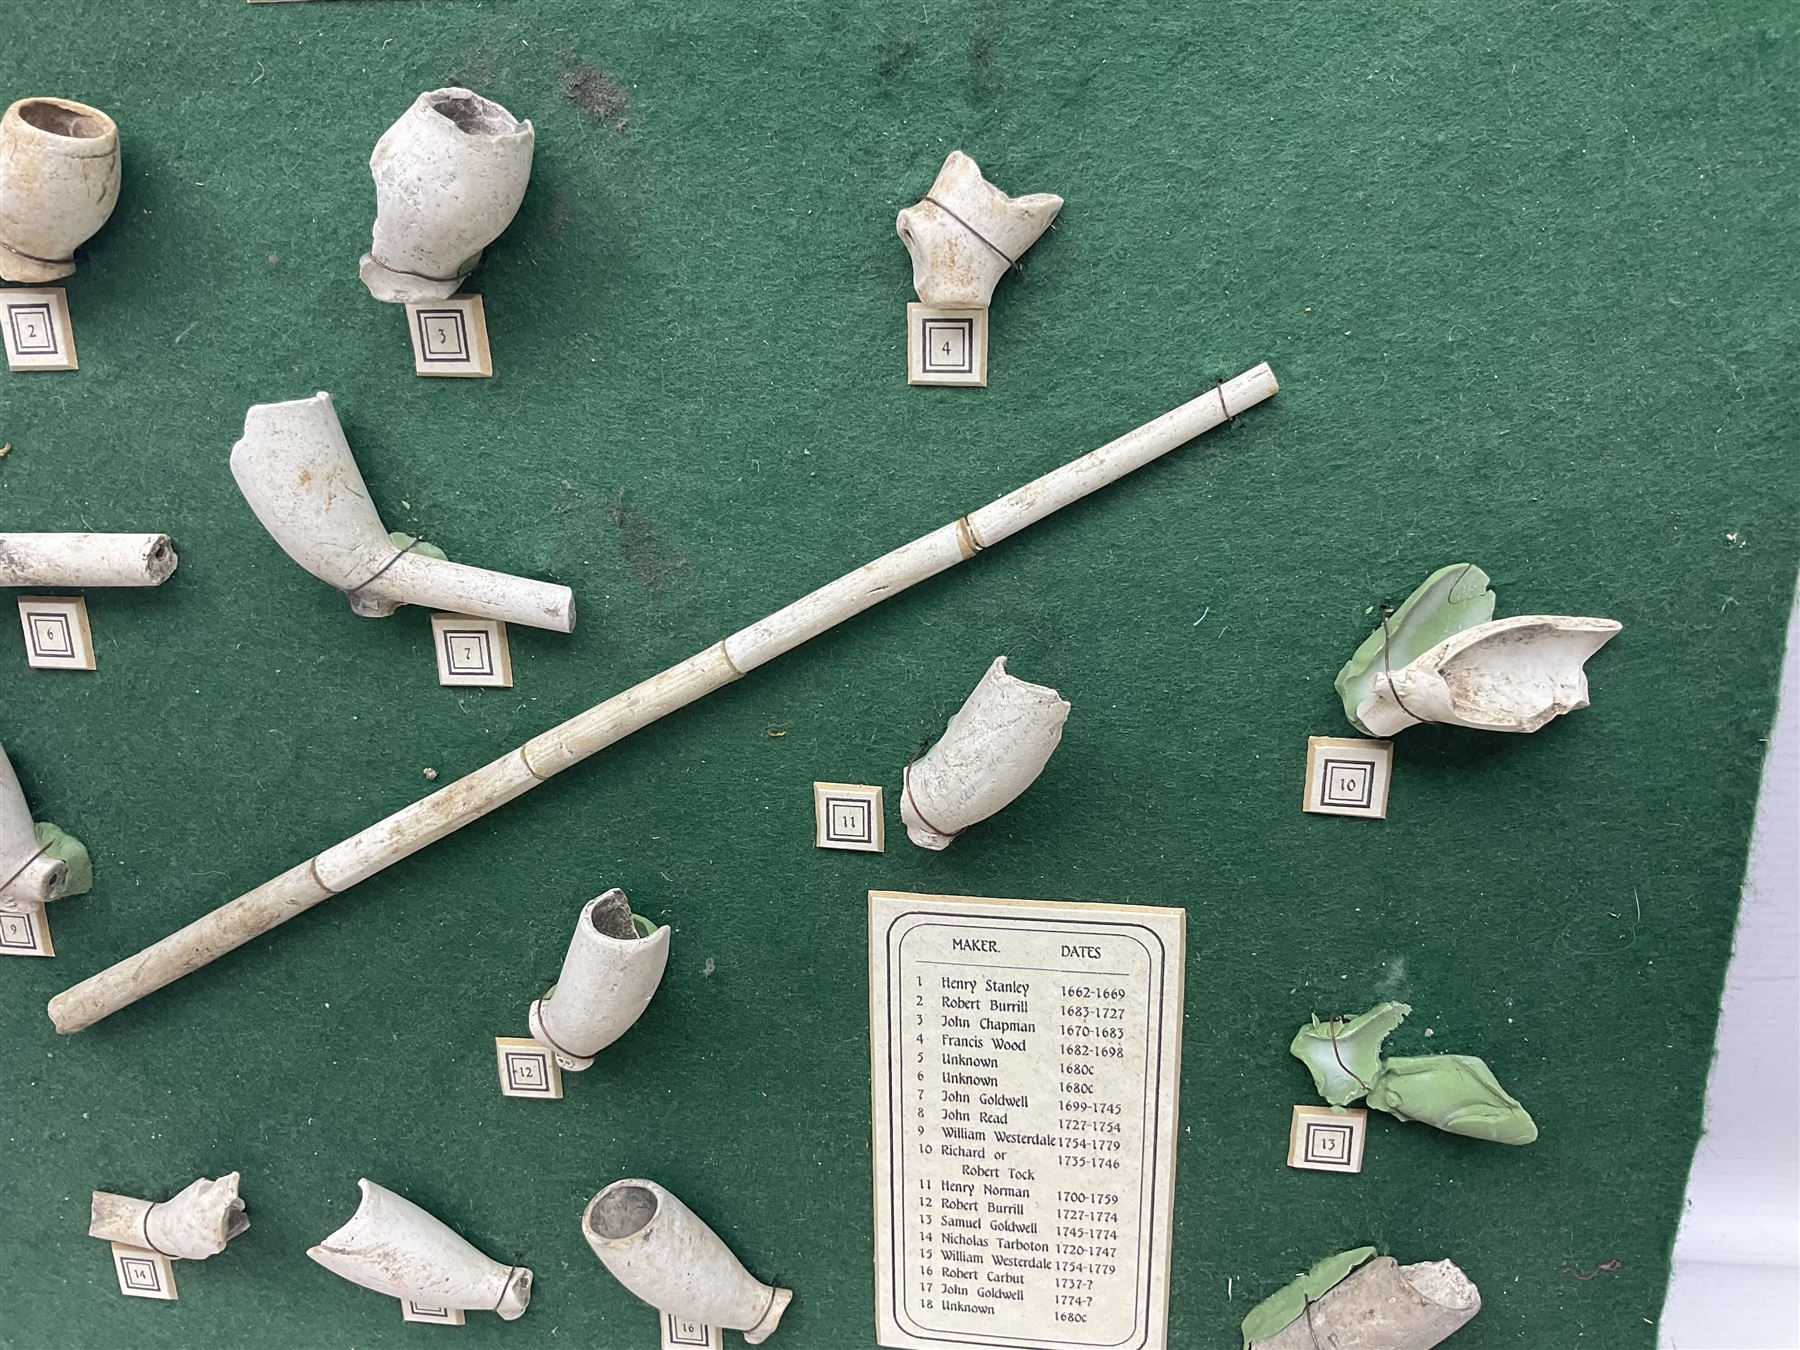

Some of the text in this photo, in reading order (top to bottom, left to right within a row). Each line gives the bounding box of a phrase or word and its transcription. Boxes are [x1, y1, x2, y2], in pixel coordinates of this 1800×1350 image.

[28, 325, 36, 338] 2
[438, 329, 446, 344] 3
[942, 341, 952, 356] 4
[47, 627, 54, 640] 6
[464, 648, 471, 660] 7
[1340, 778, 1356, 792] 10
[842, 816, 856, 829] 11
[10, 924, 16, 935] 9
[1061, 946, 1101, 959] DATES
[917, 976, 1125, 999] 1 Henry Stanley 1662-1669
[916, 996, 1125, 1020] 2 Robert Burrill 1683-1727
[916, 1015, 1124, 1039] 3 John Chapman 1670-1683
[916, 1034, 1124, 1058] 4 Francis Wood 1682-1698
[918, 1053, 924, 1063] 5
[942, 1054, 998, 1068] Unknown
[519, 1066, 533, 1078] 12
[917, 1071, 924, 1080] 6
[942, 1073, 998, 1087] Unknown
[918, 1090, 1121, 1115] 7 John Goldwell 1699-1745
[918, 1108, 1121, 1133] 8 John Read 1727-1754
[918, 1126, 1120, 1152] 9 William Westerdale 1754-1779
[1322, 1138, 1336, 1151] 13
[919, 1144, 1120, 1169] 10 Richard or 1735-1746
[962, 1165, 1034, 1181] Robert Tock
[919, 1180, 1119, 1205] 11 Henry Norman 1700-1759
[919, 1197, 1118, 1223] 12 Robert Burrill 1727-1774
[919, 1215, 1117, 1240] 13 Samuel Goldwell 1745-1774
[920, 1232, 1116, 1258] 14 Nicholas Tarboton 1720-1747
[920, 1249, 1115, 1274] 15 William Westerdale 1754-1779
[134, 1269, 146, 1280] 14
[920, 1266, 1092, 1289] 16 Robert Carbut 1737-?
[920, 1283, 1092, 1307] 17 John Goldwell 1774-?
[920, 1299, 933, 1309] 18
[942, 1300, 995, 1315] Unknown
[682, 1323, 694, 1333] 16
